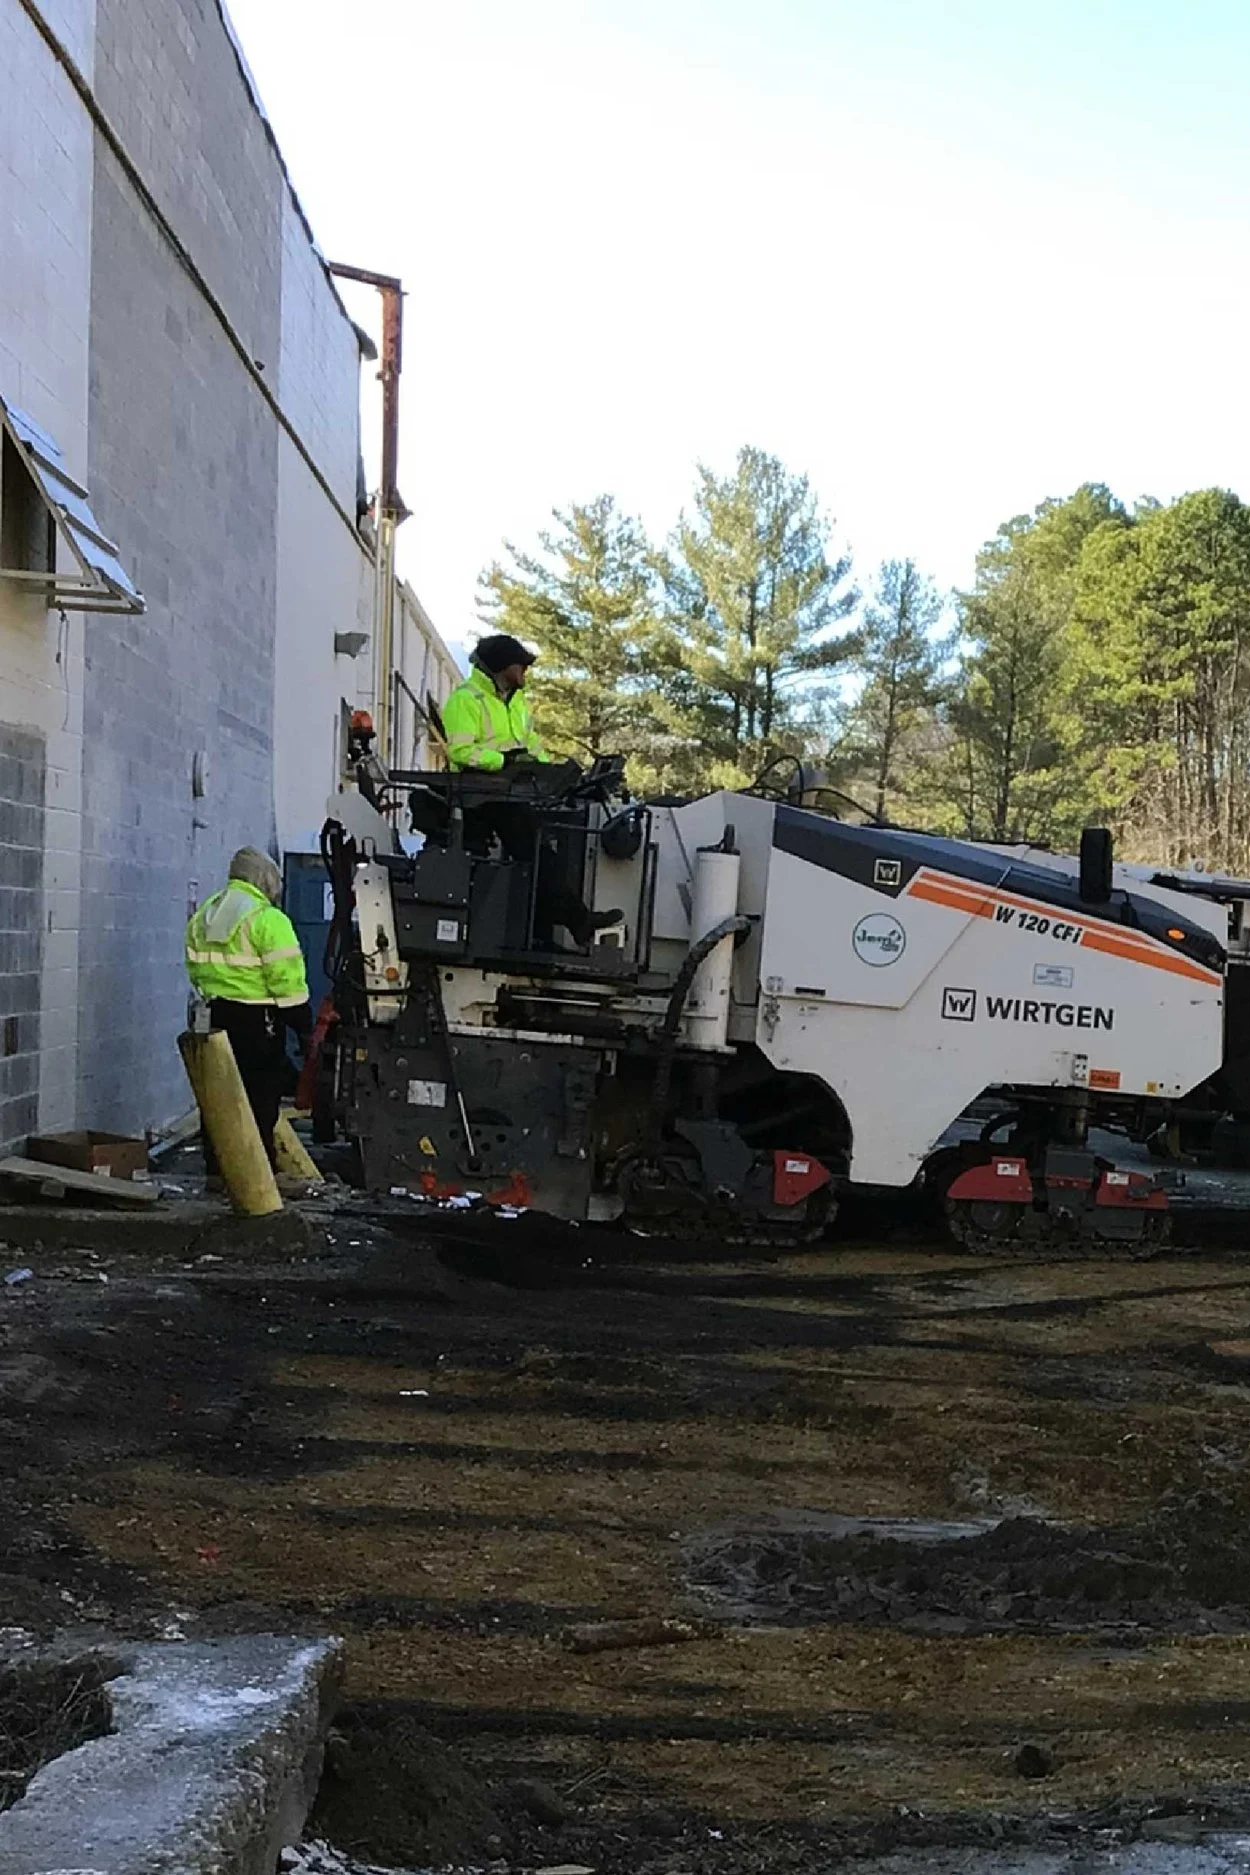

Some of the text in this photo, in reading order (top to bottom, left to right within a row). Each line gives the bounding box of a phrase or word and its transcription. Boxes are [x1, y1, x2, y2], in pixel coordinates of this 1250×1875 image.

[996, 905, 1016, 924] W
[1018, 913, 1051, 934] 120
[986, 996, 1114, 1031] WIRTGEN
